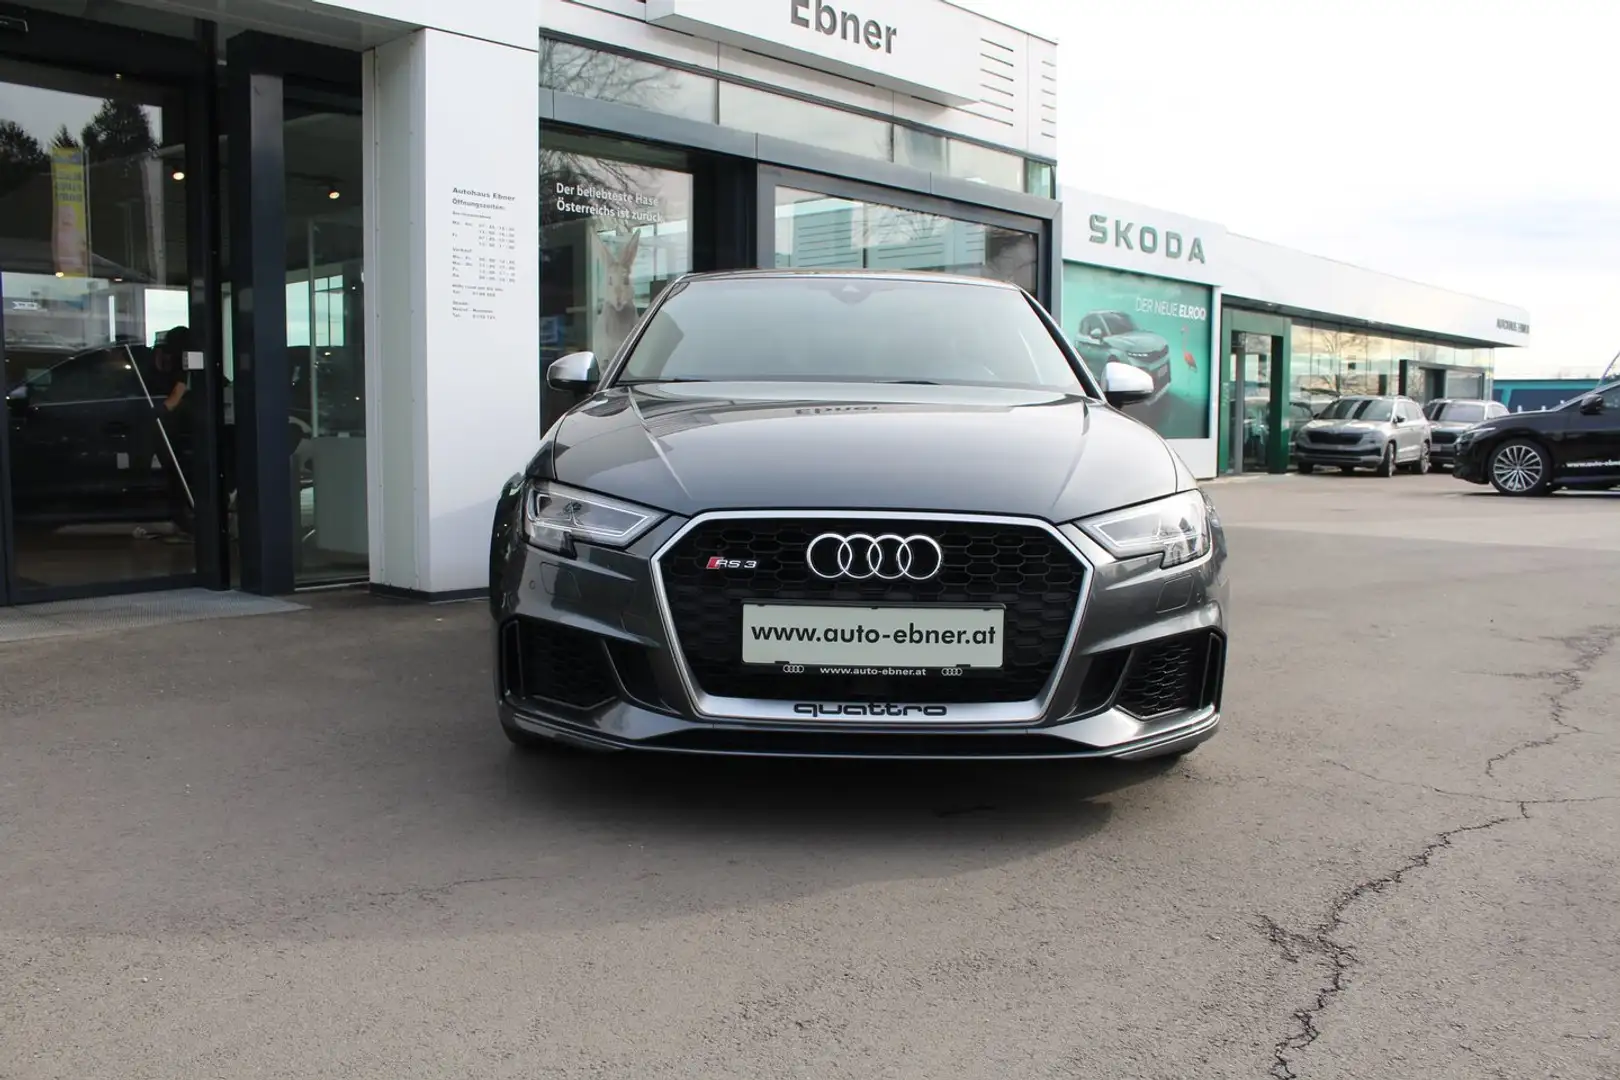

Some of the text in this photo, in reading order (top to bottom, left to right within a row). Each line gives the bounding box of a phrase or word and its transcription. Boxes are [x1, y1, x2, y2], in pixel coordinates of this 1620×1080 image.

[790, 0, 897, 54] Ebner
[452, 187, 491, 198] Autohaus
[556, 182, 659, 206] Der beliebteste Hase
[556, 196, 616, 217] Österreichs
[617, 208, 630, 219] ist
[1089, 214, 1205, 264] SKODA
[1135, 297, 1154, 313] DER
[1155, 299, 1178, 317] NEUE
[751, 622, 996, 645] www.auto-ebner.at
[819, 666, 927, 677] www.auto-ebner.at
[793, 702, 948, 718] quattro
